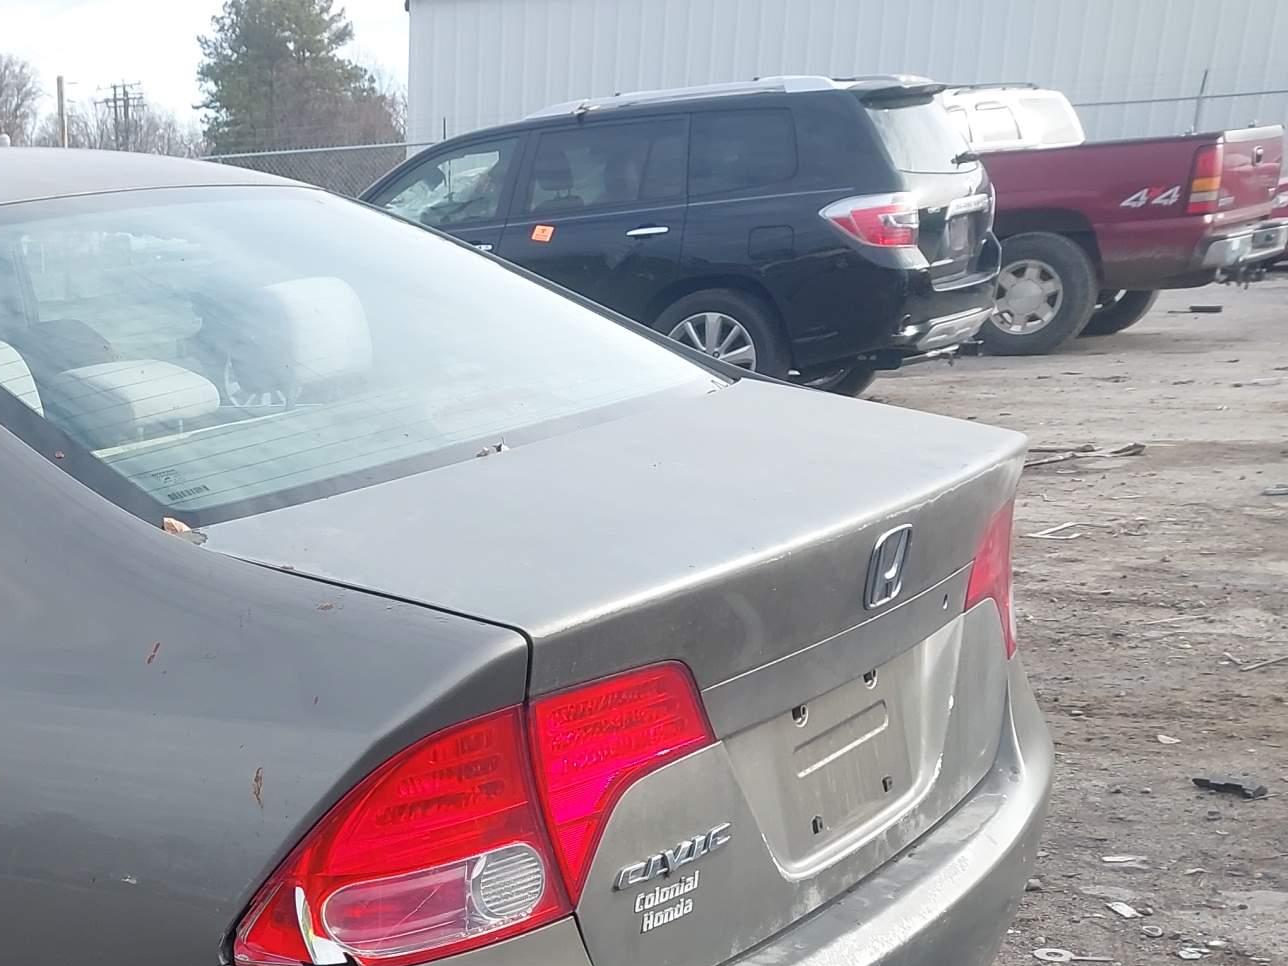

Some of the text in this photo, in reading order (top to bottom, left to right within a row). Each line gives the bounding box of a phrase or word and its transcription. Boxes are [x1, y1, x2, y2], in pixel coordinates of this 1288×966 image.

[613, 822, 731, 890] CIVIC
[634, 870, 700, 913] Colonial
[640, 897, 693, 934] Honda
